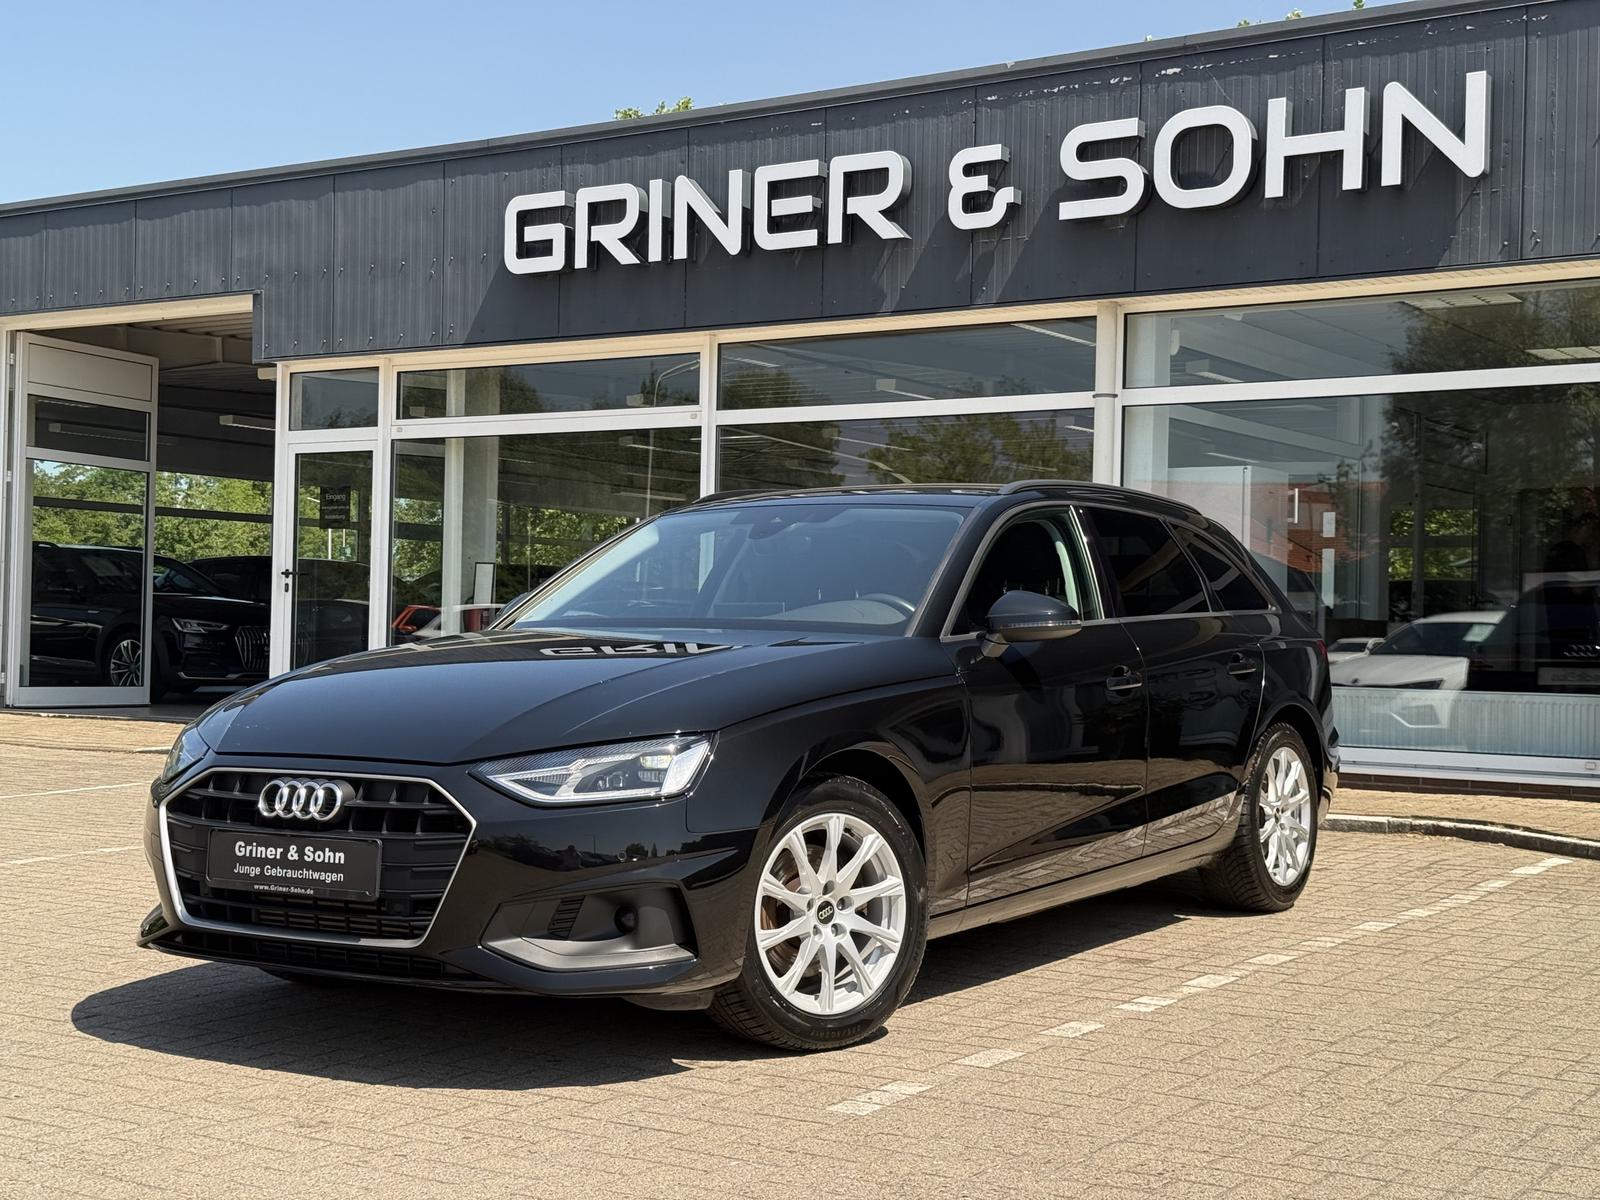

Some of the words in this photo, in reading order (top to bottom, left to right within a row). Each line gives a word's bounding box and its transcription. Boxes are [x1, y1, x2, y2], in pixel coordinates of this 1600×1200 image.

[504, 150, 910, 275] GRINER
[948, 144, 1020, 230] &
[1059, 70, 1490, 220] SOHN
[234, 841, 284, 860] Griner
[287, 845, 299, 860] &
[304, 846, 345, 864] Sohn
[234, 863, 261, 877] Junge
[264, 865, 344, 883] Gebrauchtwagen
[254, 884, 314, 895] www.Griner-Sohn.de
